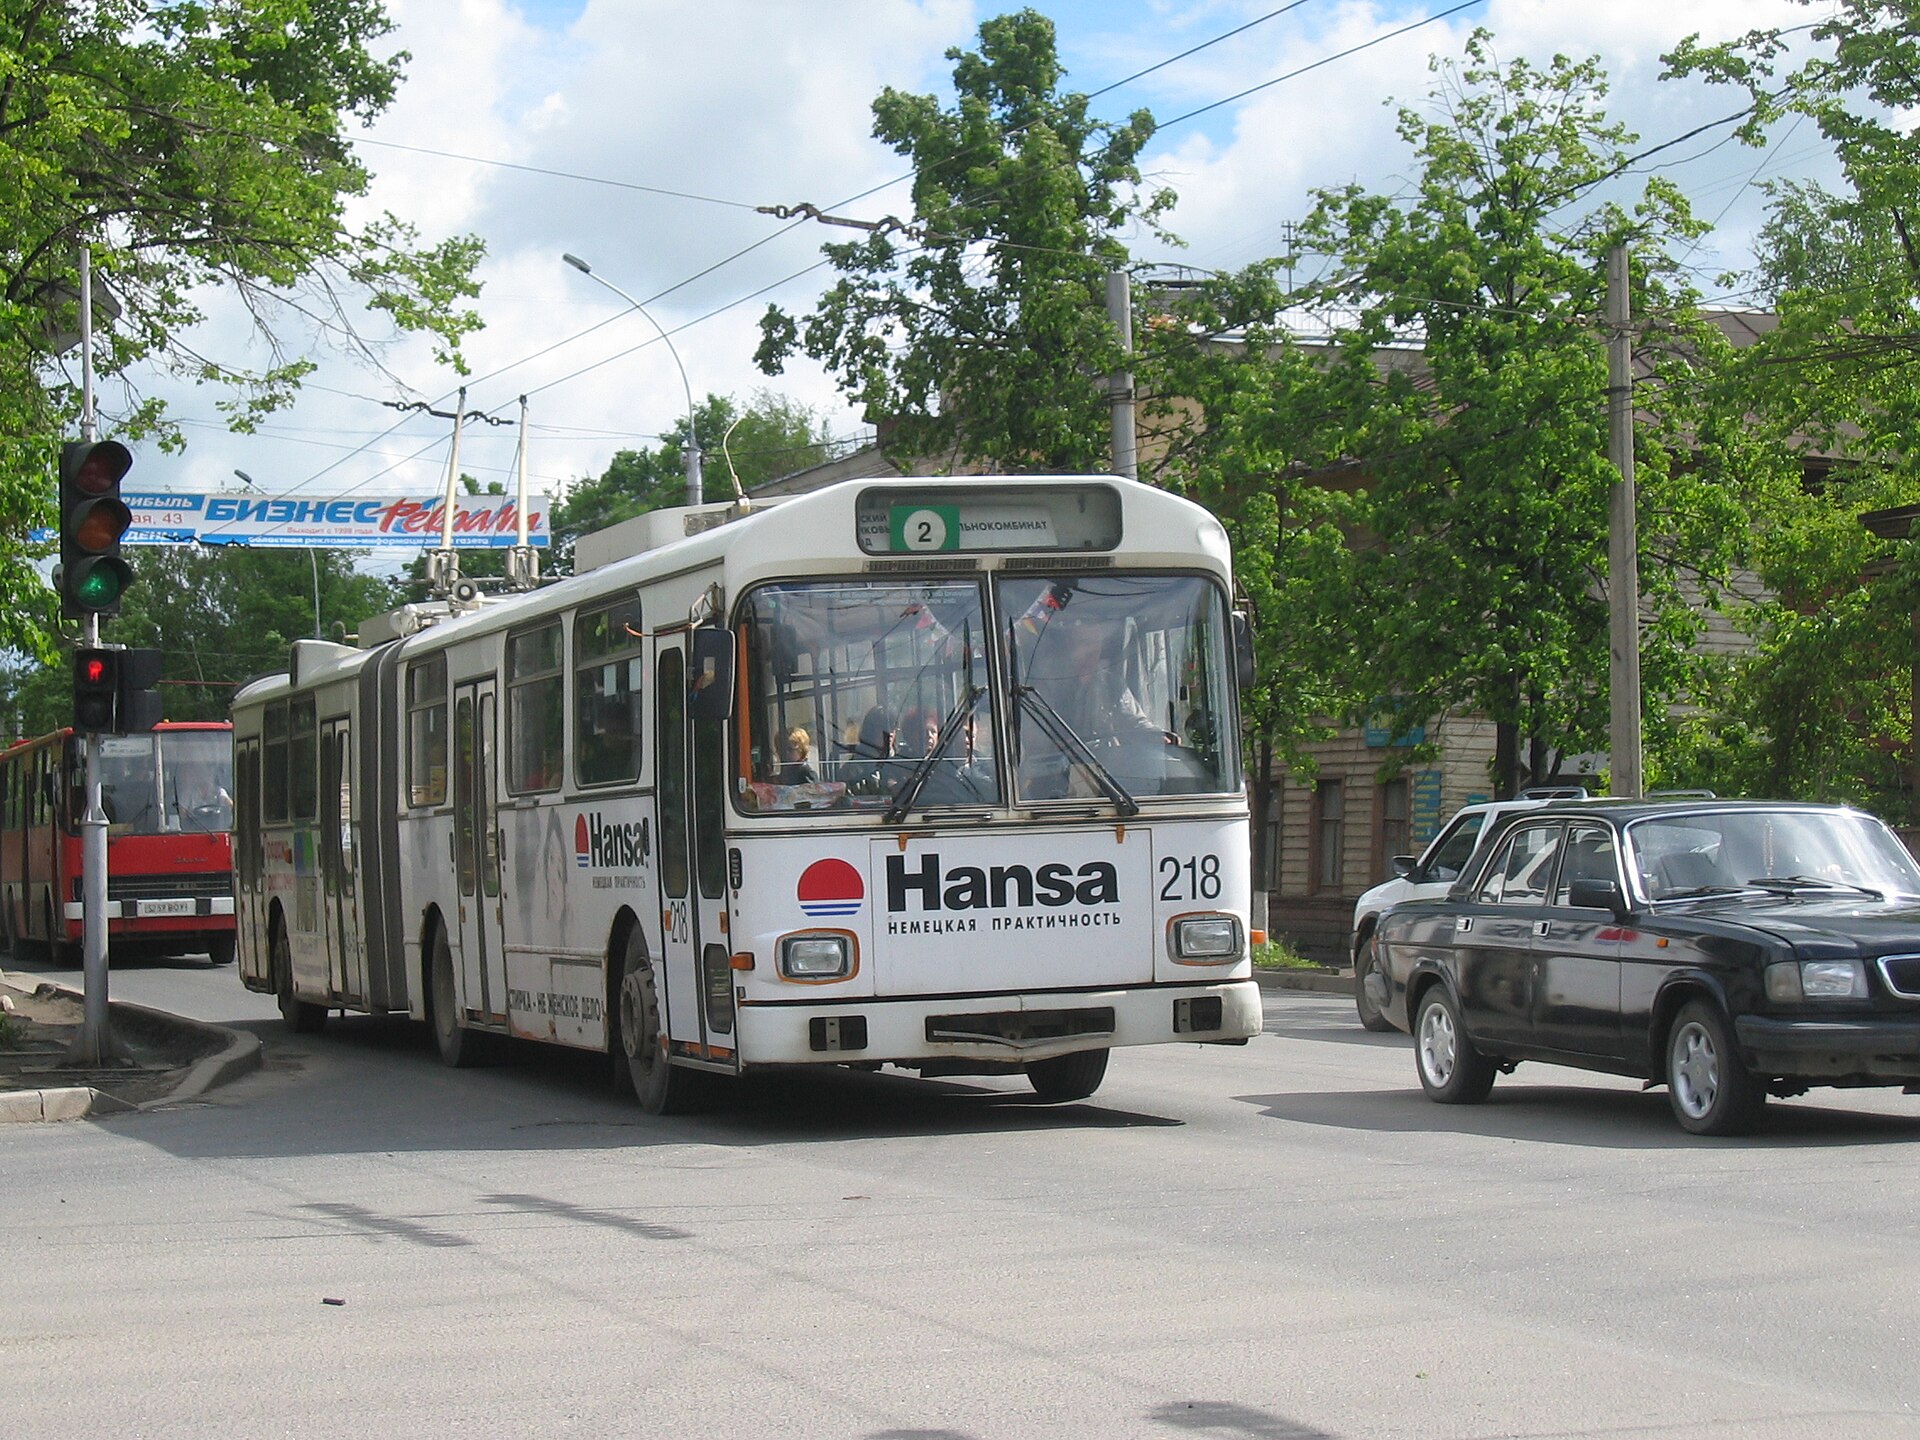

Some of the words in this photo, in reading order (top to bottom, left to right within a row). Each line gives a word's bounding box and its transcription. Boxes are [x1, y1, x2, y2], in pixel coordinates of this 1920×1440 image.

[162, 513, 183, 525] 43
[204, 499, 381, 523] БИЗНЕС
[918, 522, 932, 542] 2
[590, 812, 645, 868] Hansa
[886, 853, 1121, 912] Hansa
[1159, 854, 1222, 901] 218
[671, 901, 688, 944] 218
[888, 918, 977, 935] НЕМЕЦКАЯ
[992, 912, 1121, 931] ПРАКТИЧНОСТЬ
